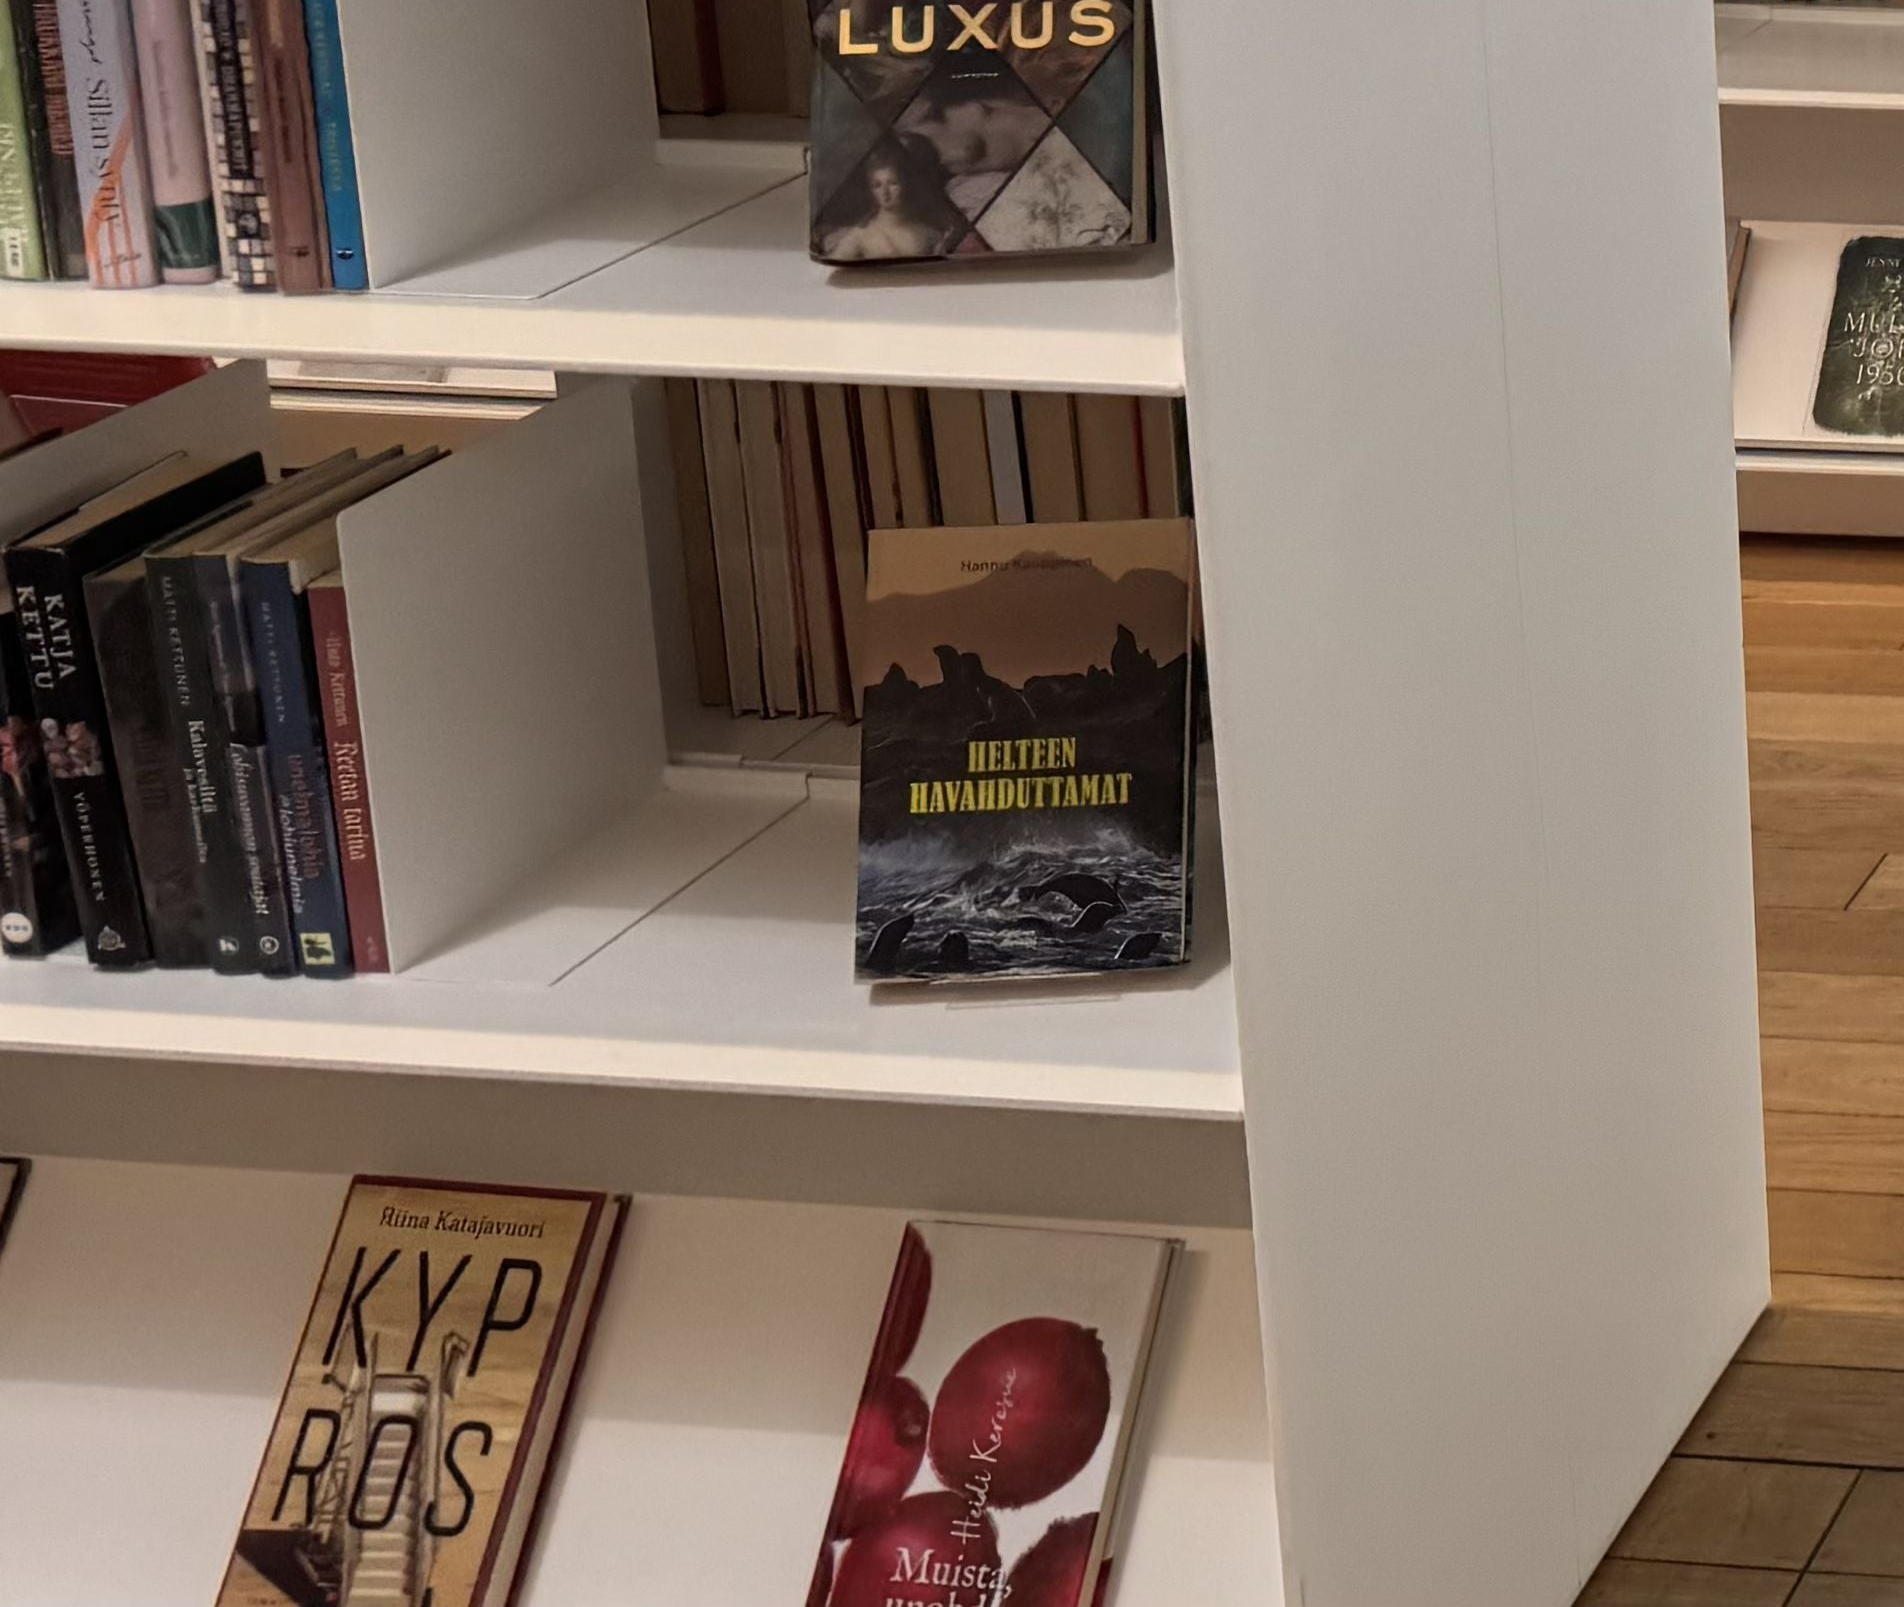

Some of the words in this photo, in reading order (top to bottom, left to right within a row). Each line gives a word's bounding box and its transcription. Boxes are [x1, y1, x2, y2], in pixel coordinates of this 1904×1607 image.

[87, 77, 115, 156] Sillan
[16, 585, 55, 691] KETTU
[44, 593, 77, 679] KATJA
[910, 772, 1132, 814] HAVAHDUTTAMAT
[967, 737, 1076, 773] HELTEEN
[380, 1206, 429, 1230] Riina
[435, 1209, 545, 1239] Katajavuori
[321, 1246, 542, 1378] KYP
[271, 1408, 492, 1537] ROS
[950, 1469, 991, 1544] Heidi
[890, 1547, 1012, 1598] Muista,
